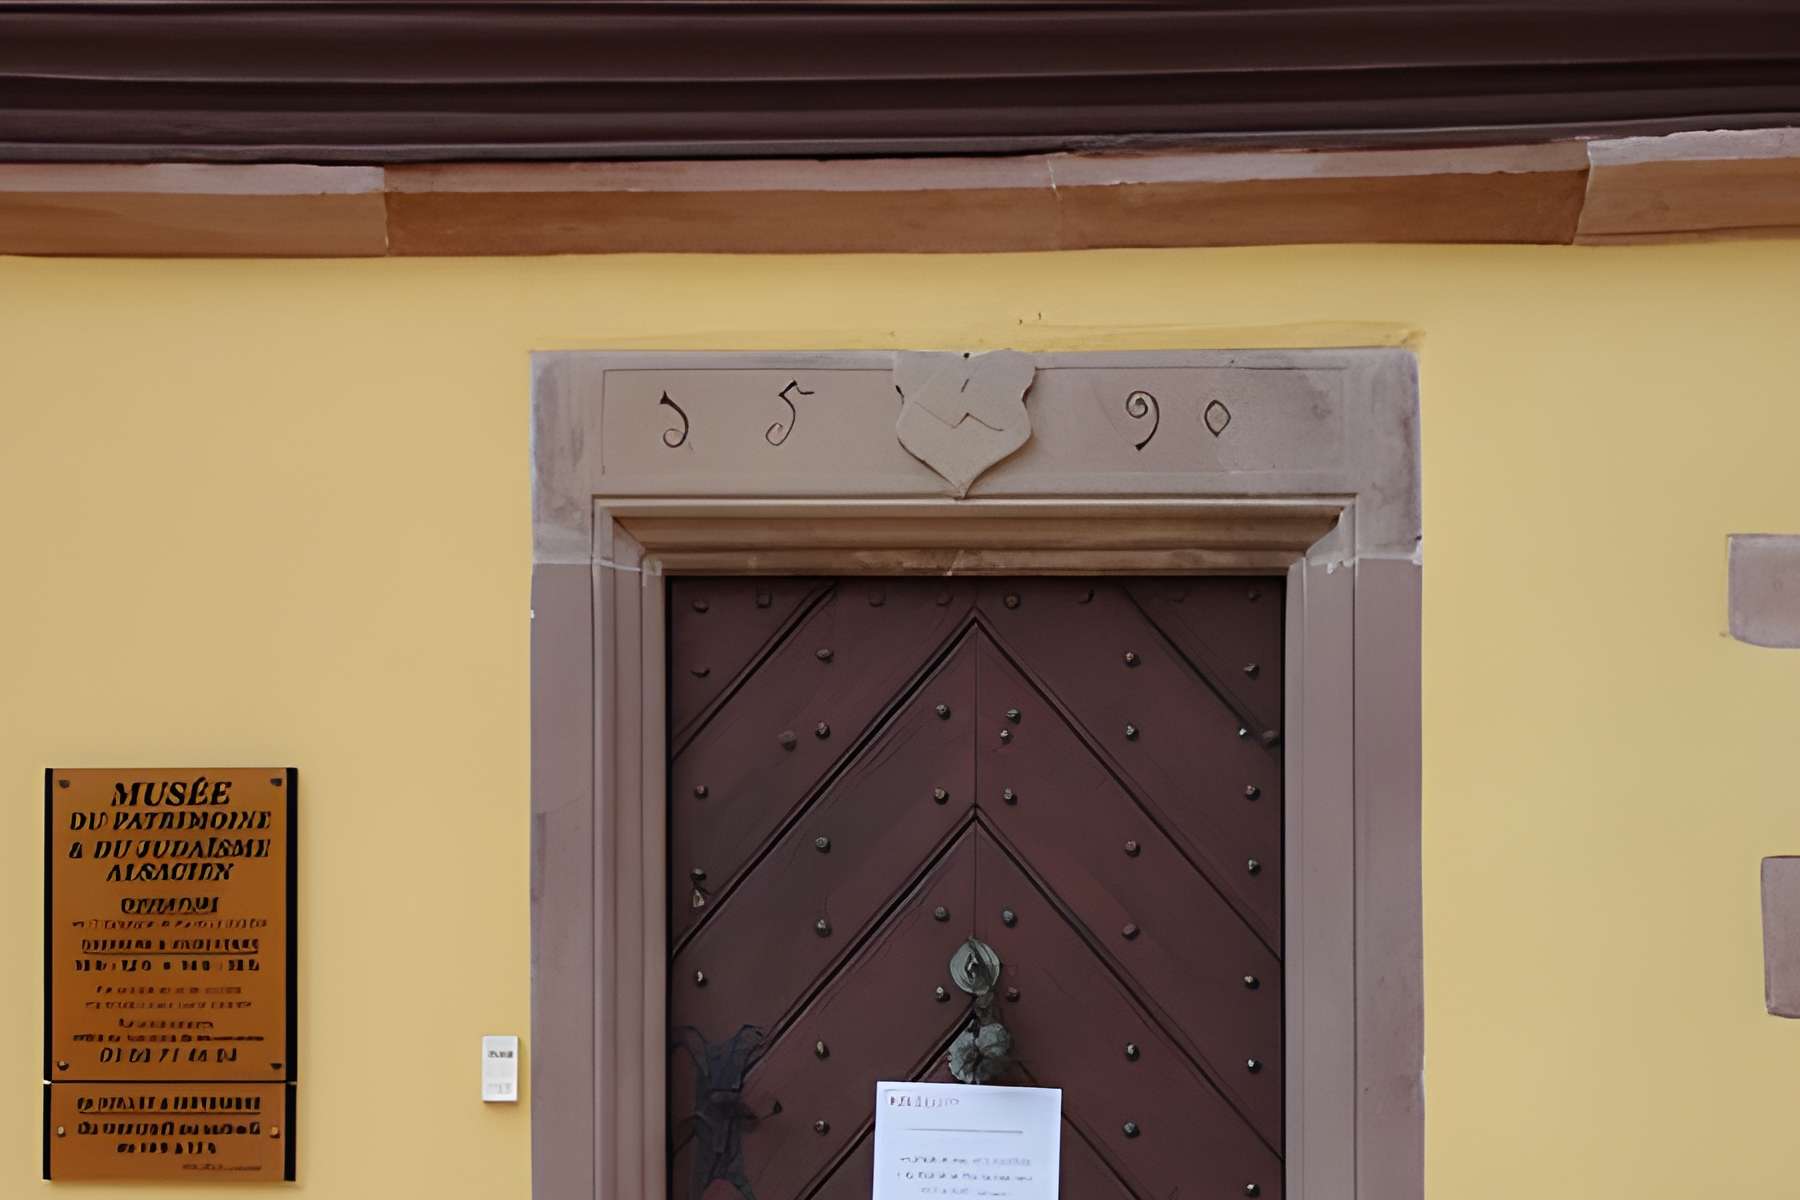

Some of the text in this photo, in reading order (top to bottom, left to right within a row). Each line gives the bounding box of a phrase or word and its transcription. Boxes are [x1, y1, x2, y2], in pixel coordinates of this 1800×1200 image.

[111, 776, 233, 807] MUSÉE
[113, 811, 271, 831] PATRIMOINE
[93, 839, 132, 859] DU
